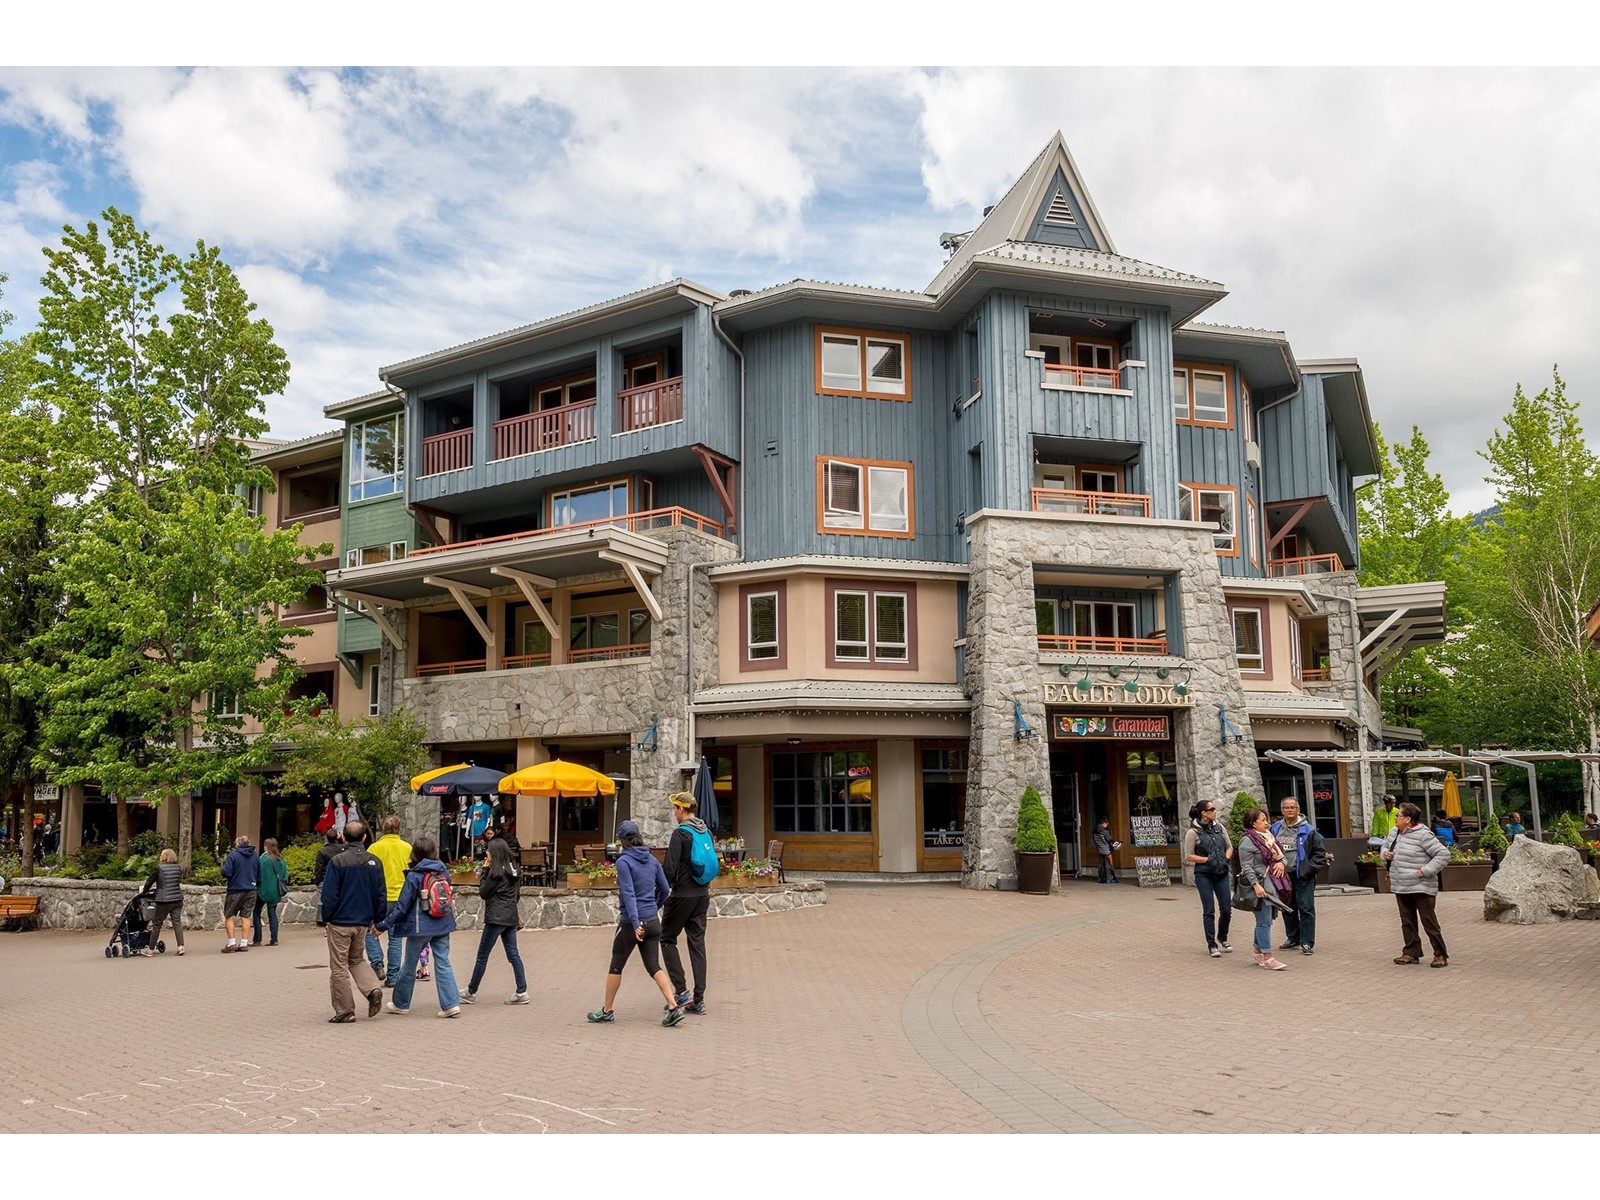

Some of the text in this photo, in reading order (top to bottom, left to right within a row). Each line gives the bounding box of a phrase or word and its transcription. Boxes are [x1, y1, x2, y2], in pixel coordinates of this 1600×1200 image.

[1044, 684, 1197, 704] EAGLE LODGE
[1112, 716, 1165, 732] Caramba!
[933, 837, 955, 845] TAKE
